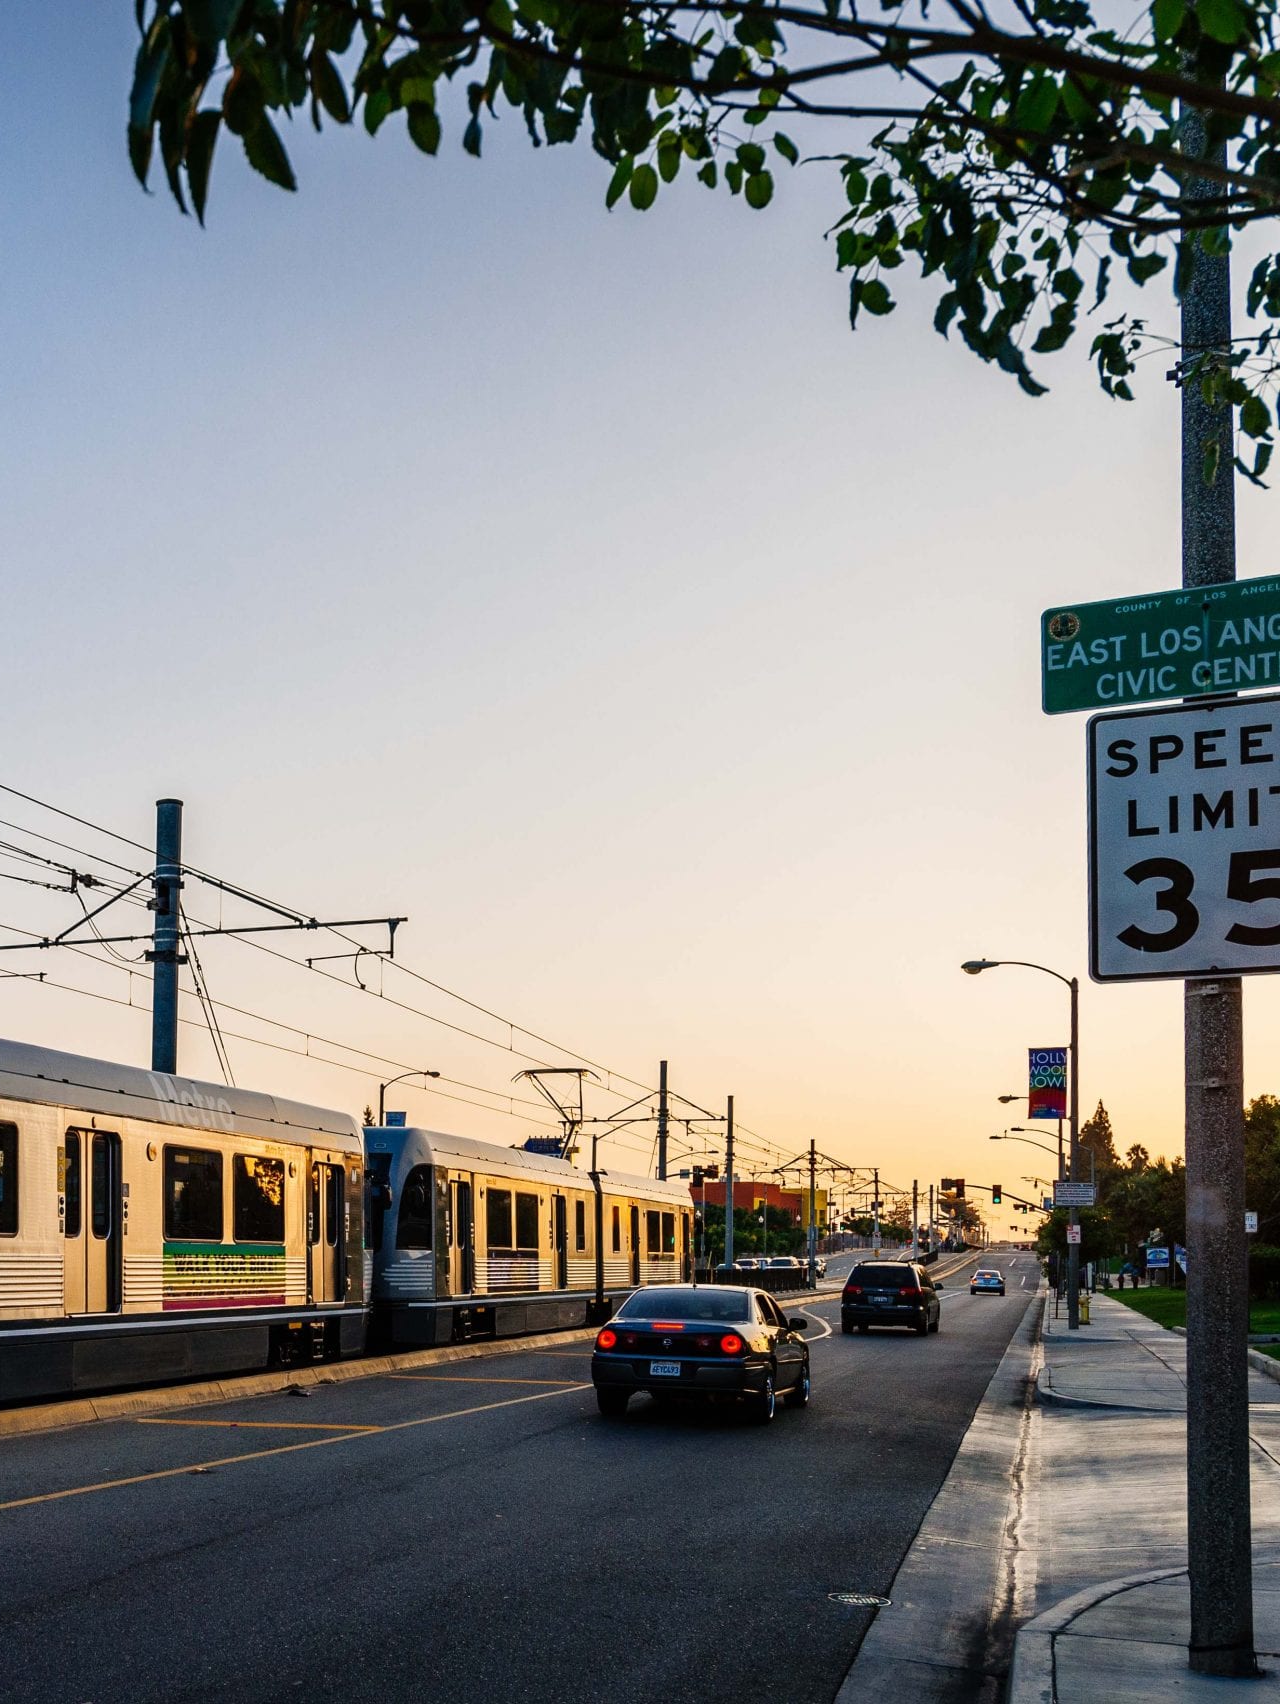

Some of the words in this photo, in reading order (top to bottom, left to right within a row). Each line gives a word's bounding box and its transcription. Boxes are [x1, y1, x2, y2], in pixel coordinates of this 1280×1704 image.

[1115, 600, 1163, 614] COUNTY
[1175, 596, 1191, 606] OF
[1204, 591, 1227, 601] LOS
[1047, 635, 1127, 671] EAST
[1140, 625, 1202, 658] LOS
[1217, 613, 1280, 648] ANG
[1096, 665, 1177, 699] CIVIC
[1191, 651, 1280, 687] CENT
[1105, 724, 1274, 778] SPEE
[1116, 848, 1280, 953] 35
[148, 1073, 235, 1130] Metro
